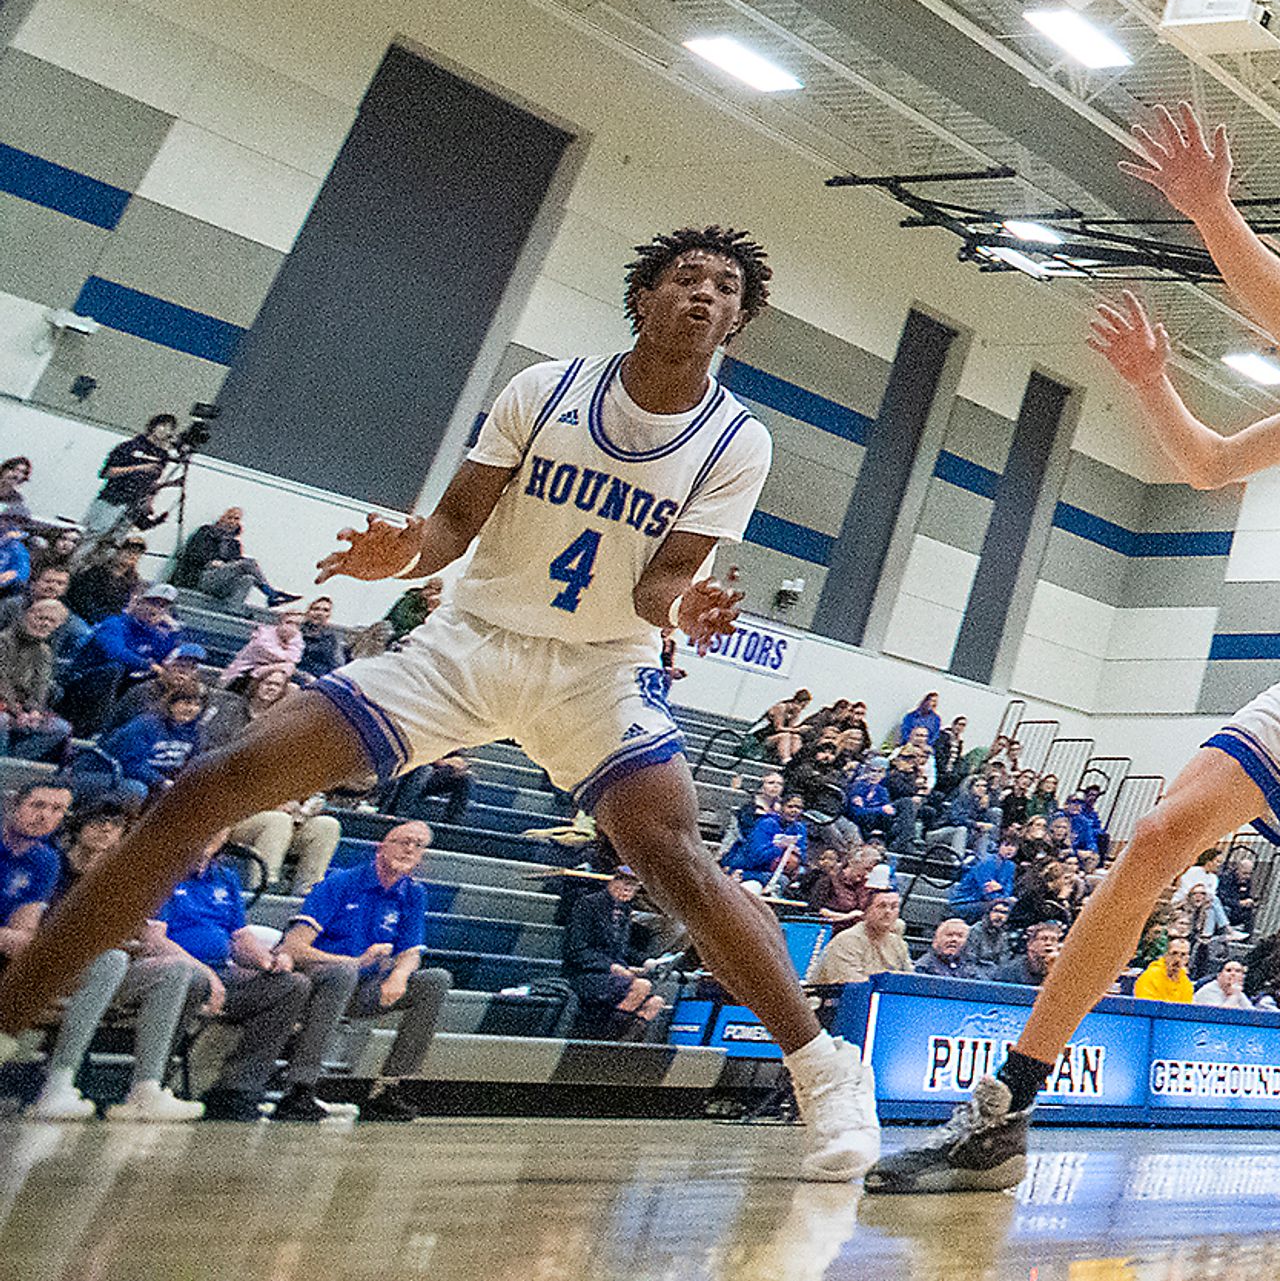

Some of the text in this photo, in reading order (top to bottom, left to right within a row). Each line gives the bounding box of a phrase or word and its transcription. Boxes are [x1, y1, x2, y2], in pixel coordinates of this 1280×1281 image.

[524, 455, 680, 539] HOUNDS
[549, 528, 603, 614] 4
[689, 627, 787, 670] SITORS
[924, 1035, 1106, 1098] PULAN
